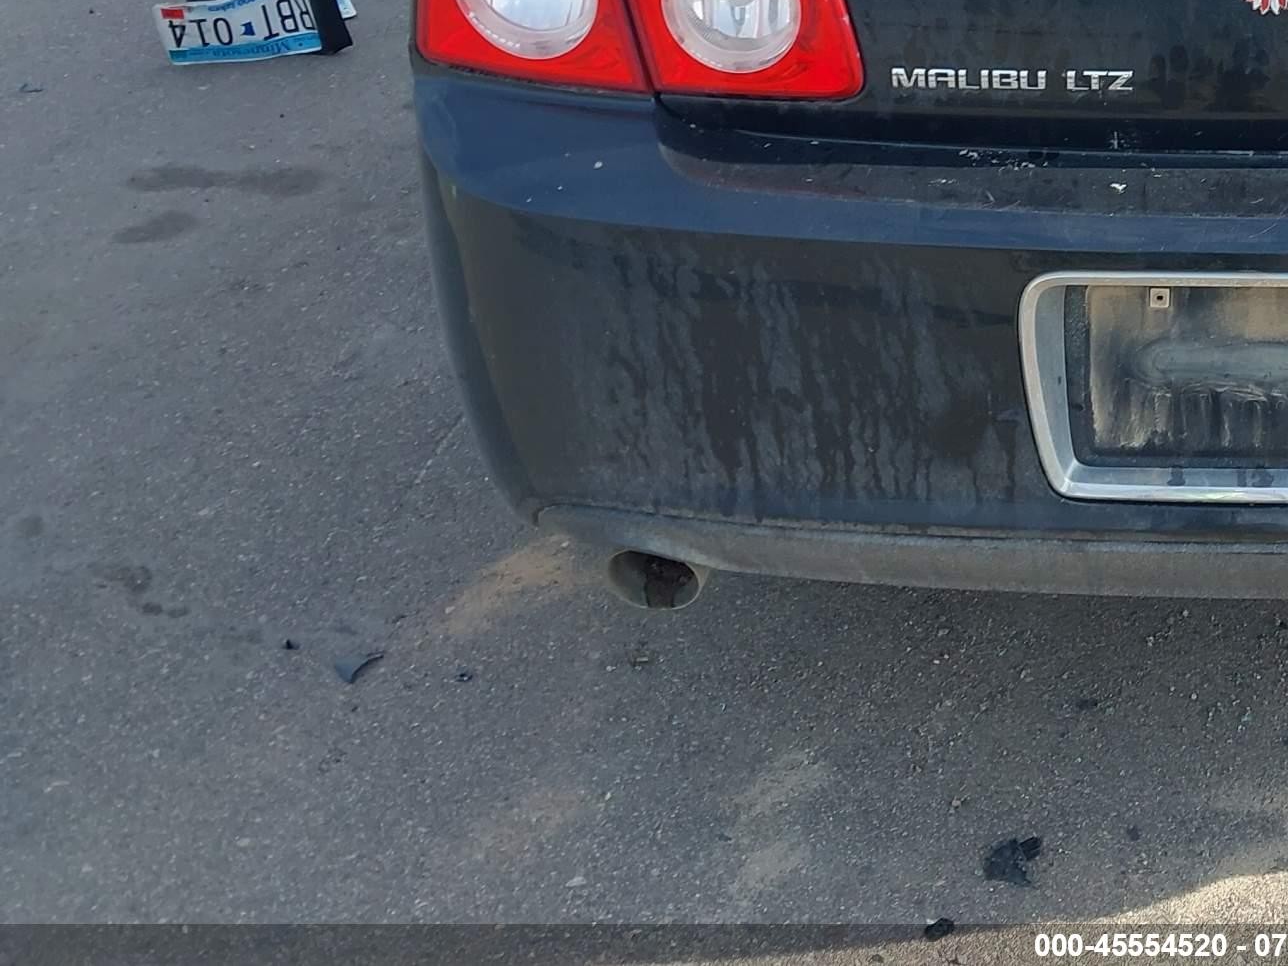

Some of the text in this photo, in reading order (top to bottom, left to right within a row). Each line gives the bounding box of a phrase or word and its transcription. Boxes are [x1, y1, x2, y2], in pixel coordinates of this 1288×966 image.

[168, 17, 234, 48] 014
[211, 41, 291, 58] Minnesota
[891, 67, 1134, 91] MALIBU LTZ
